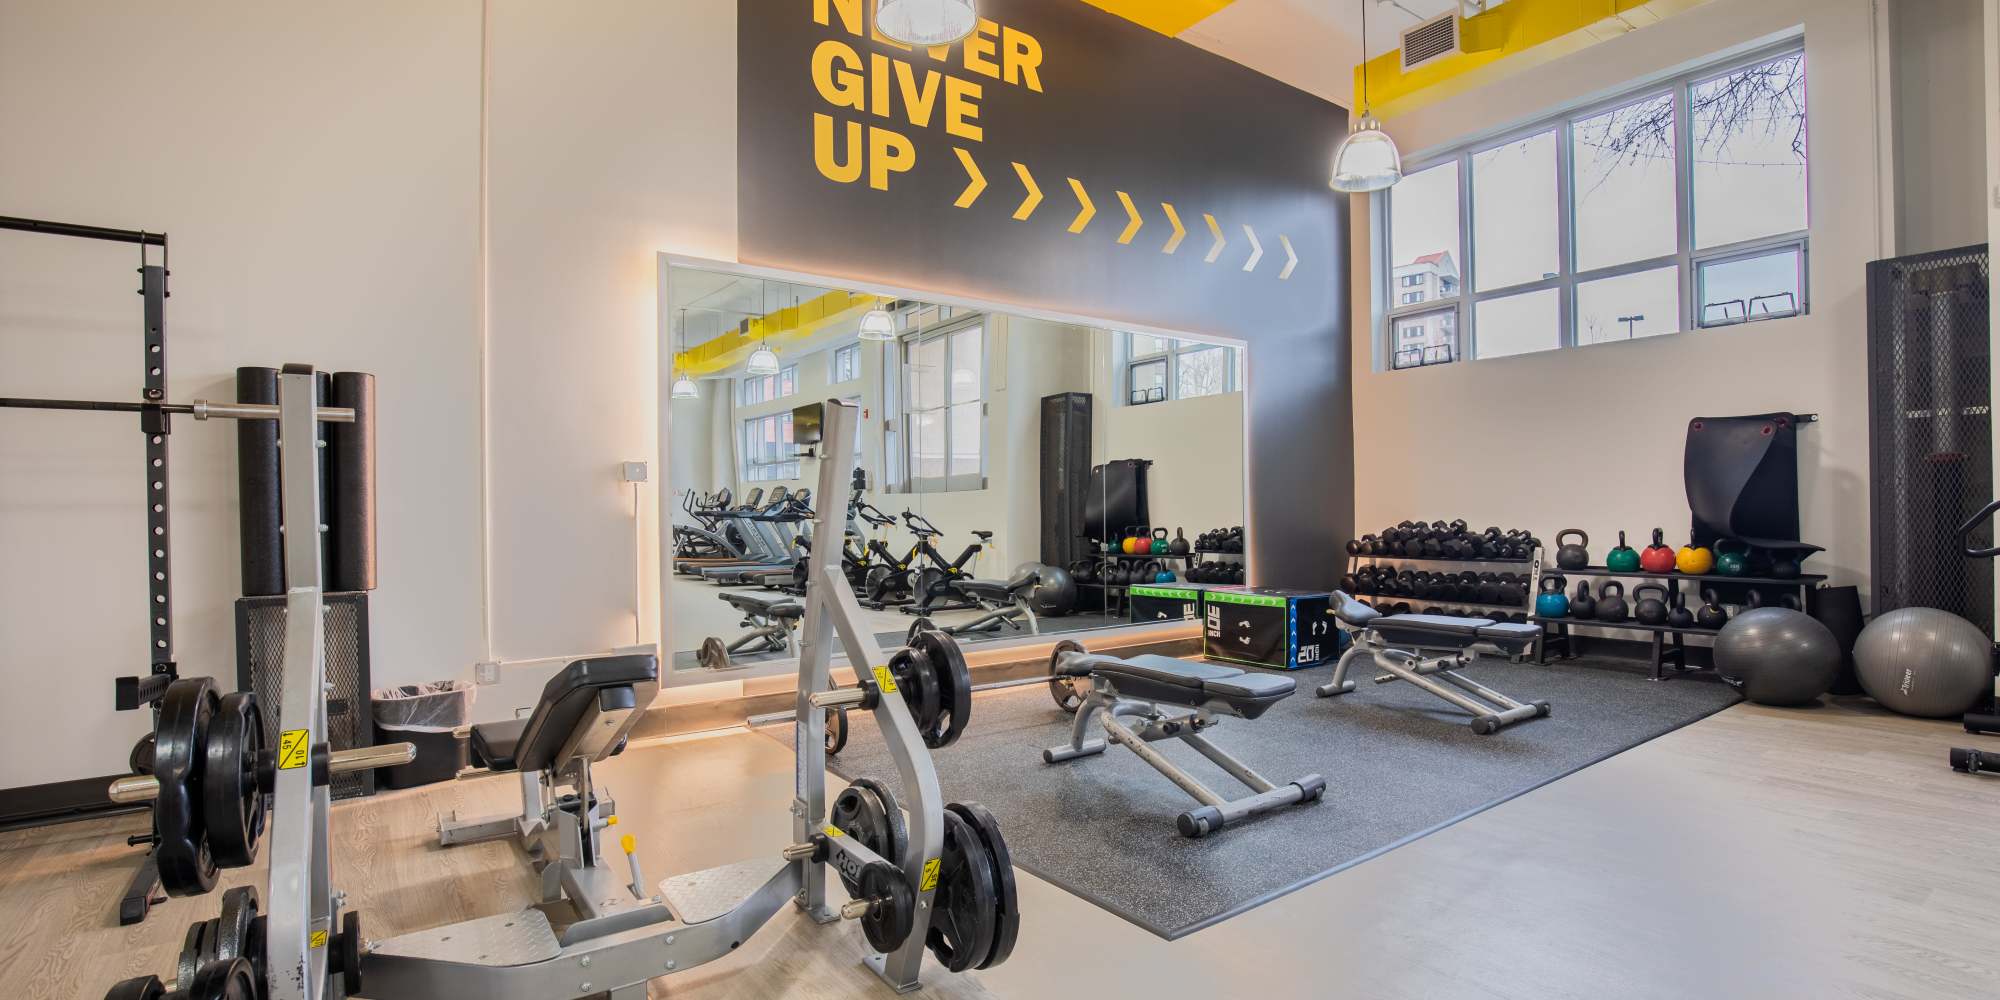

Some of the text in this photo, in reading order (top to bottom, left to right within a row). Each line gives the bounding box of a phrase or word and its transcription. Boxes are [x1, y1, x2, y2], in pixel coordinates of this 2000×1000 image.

[813, 0, 1043, 93] NER
[811, 40, 983, 142] GIVE
[813, 112, 916, 191] UP
[1207, 604, 1221, 630] 30
[1297, 644, 1315, 664] 20
